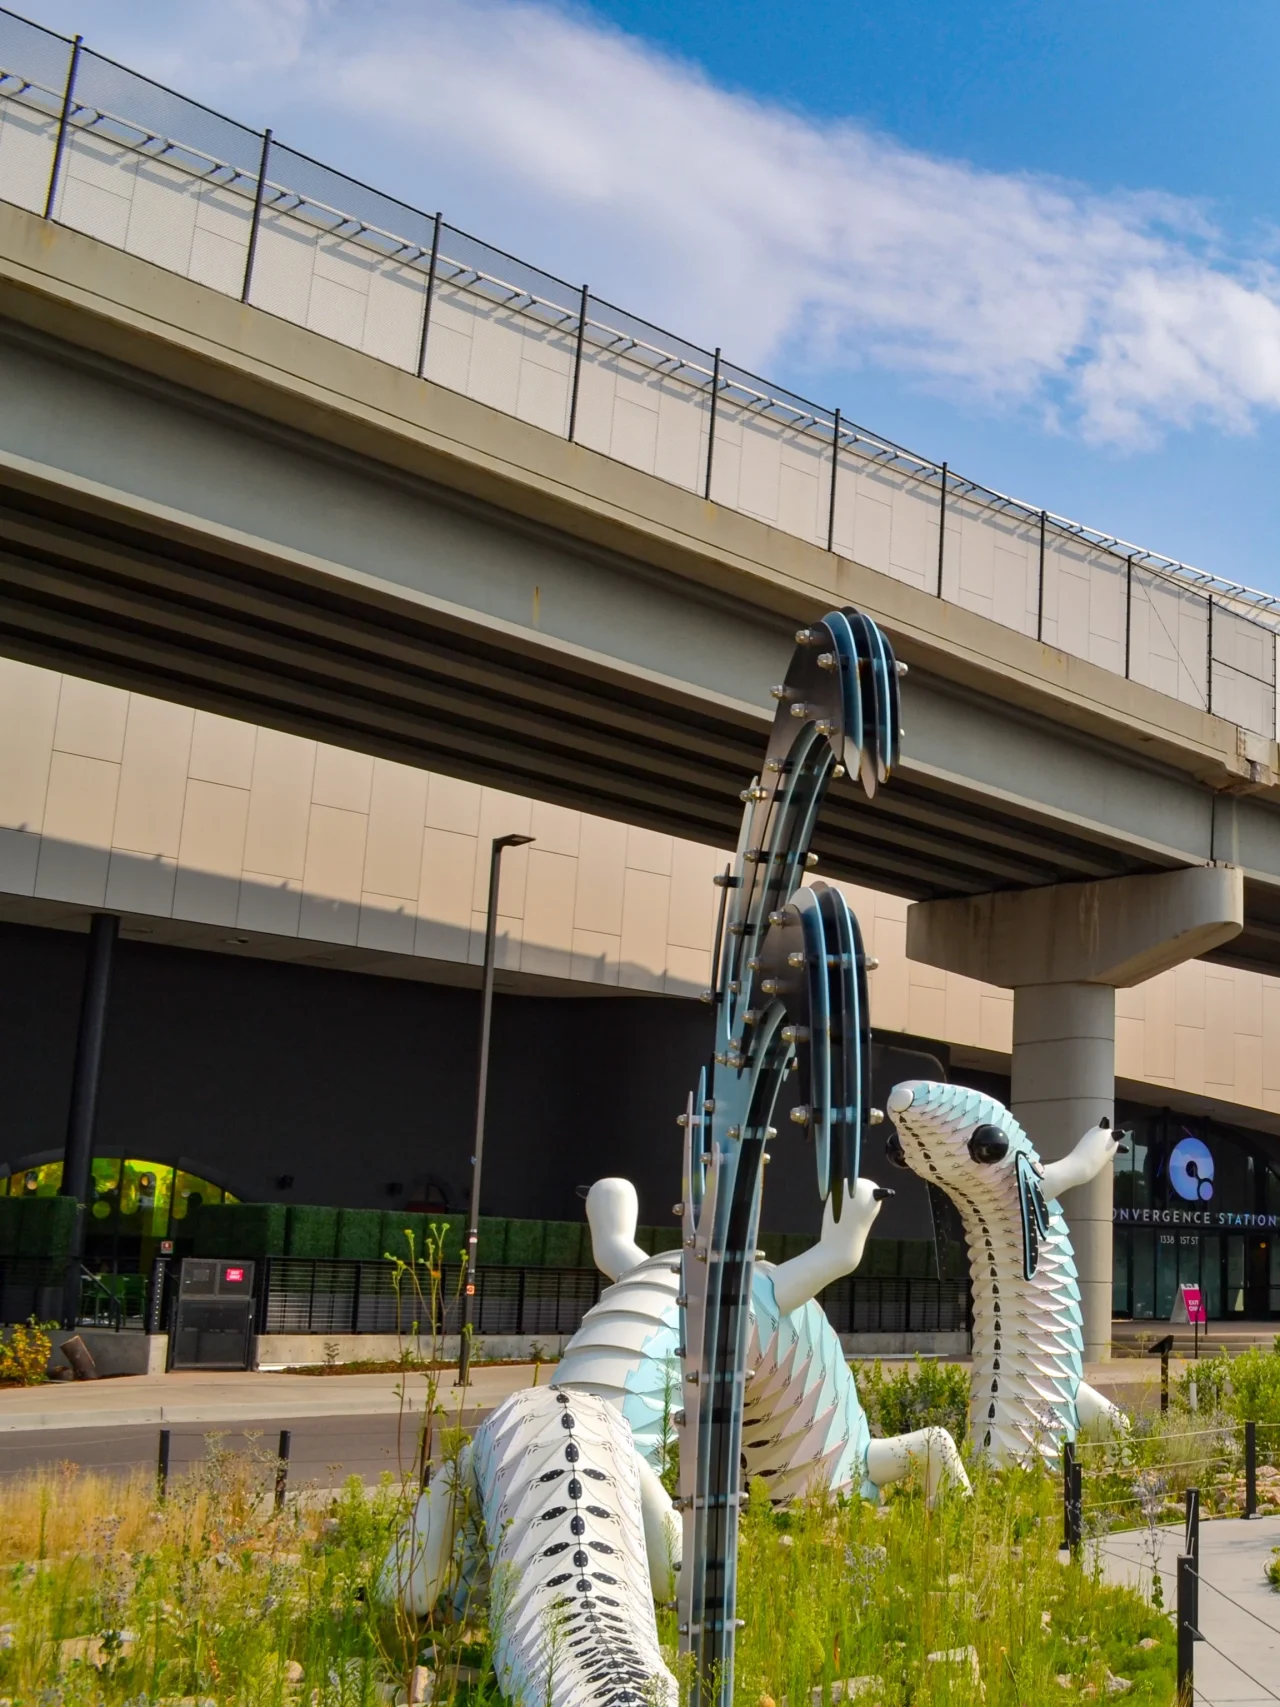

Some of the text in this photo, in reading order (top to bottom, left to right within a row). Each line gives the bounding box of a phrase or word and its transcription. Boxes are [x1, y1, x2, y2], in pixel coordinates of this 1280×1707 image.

[1218, 1212, 1277, 1226] STATION
[1160, 1235, 1175, 1244] 1338
[1191, 1236, 1199, 1245] ST
